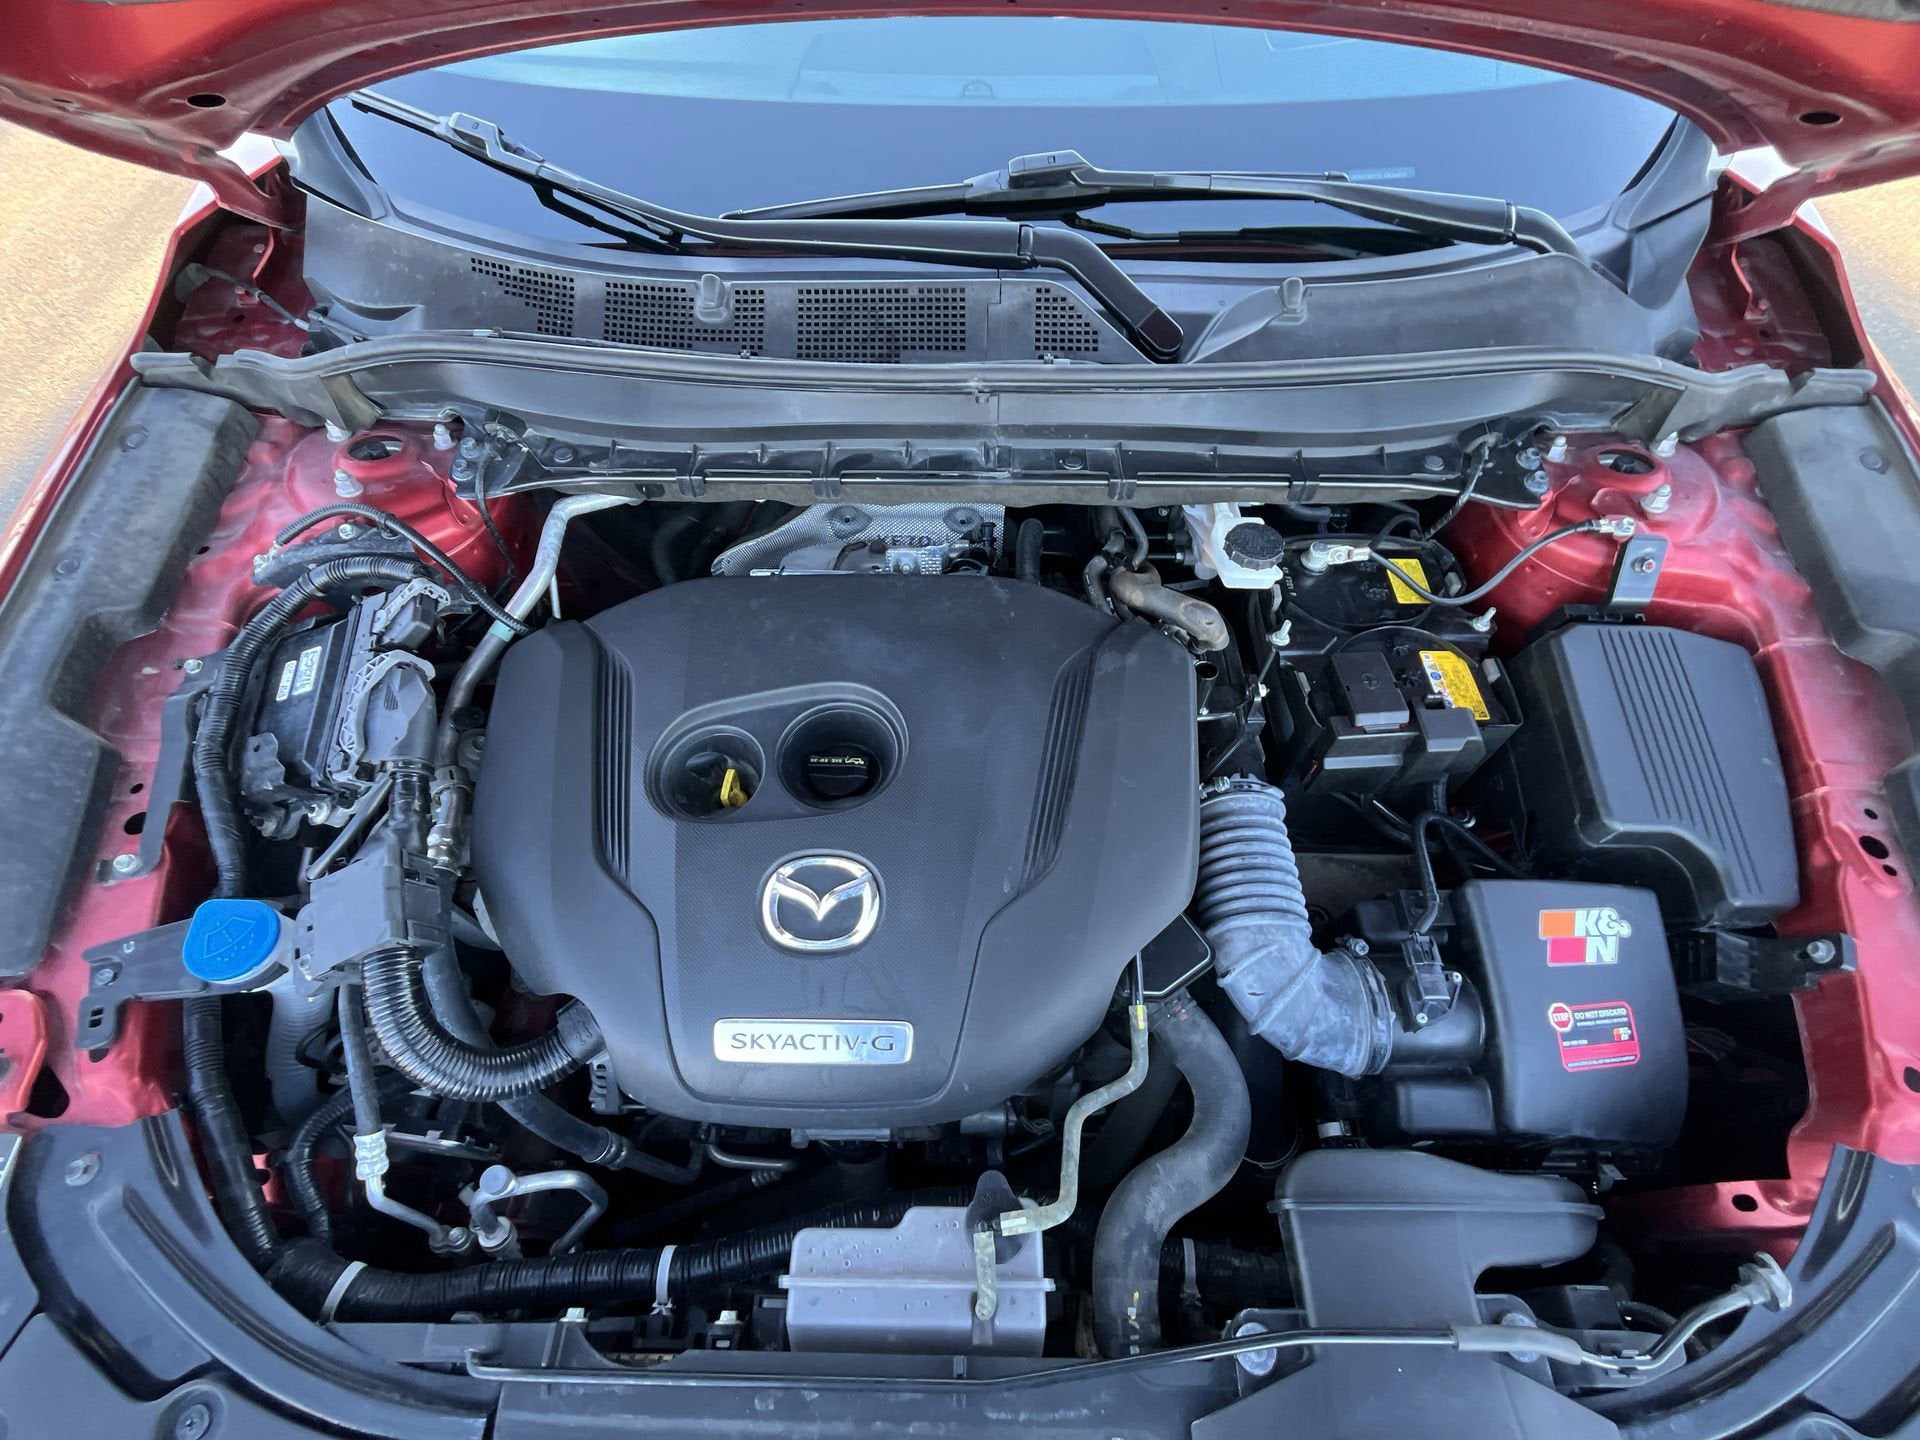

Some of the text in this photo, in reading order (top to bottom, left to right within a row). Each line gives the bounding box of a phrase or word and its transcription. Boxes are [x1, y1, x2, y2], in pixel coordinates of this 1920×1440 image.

[1552, 1012, 1570, 1022] STOP
[1598, 1007, 1627, 1017] DISCARD
[730, 1032, 895, 1051] SKYACTIV-G
